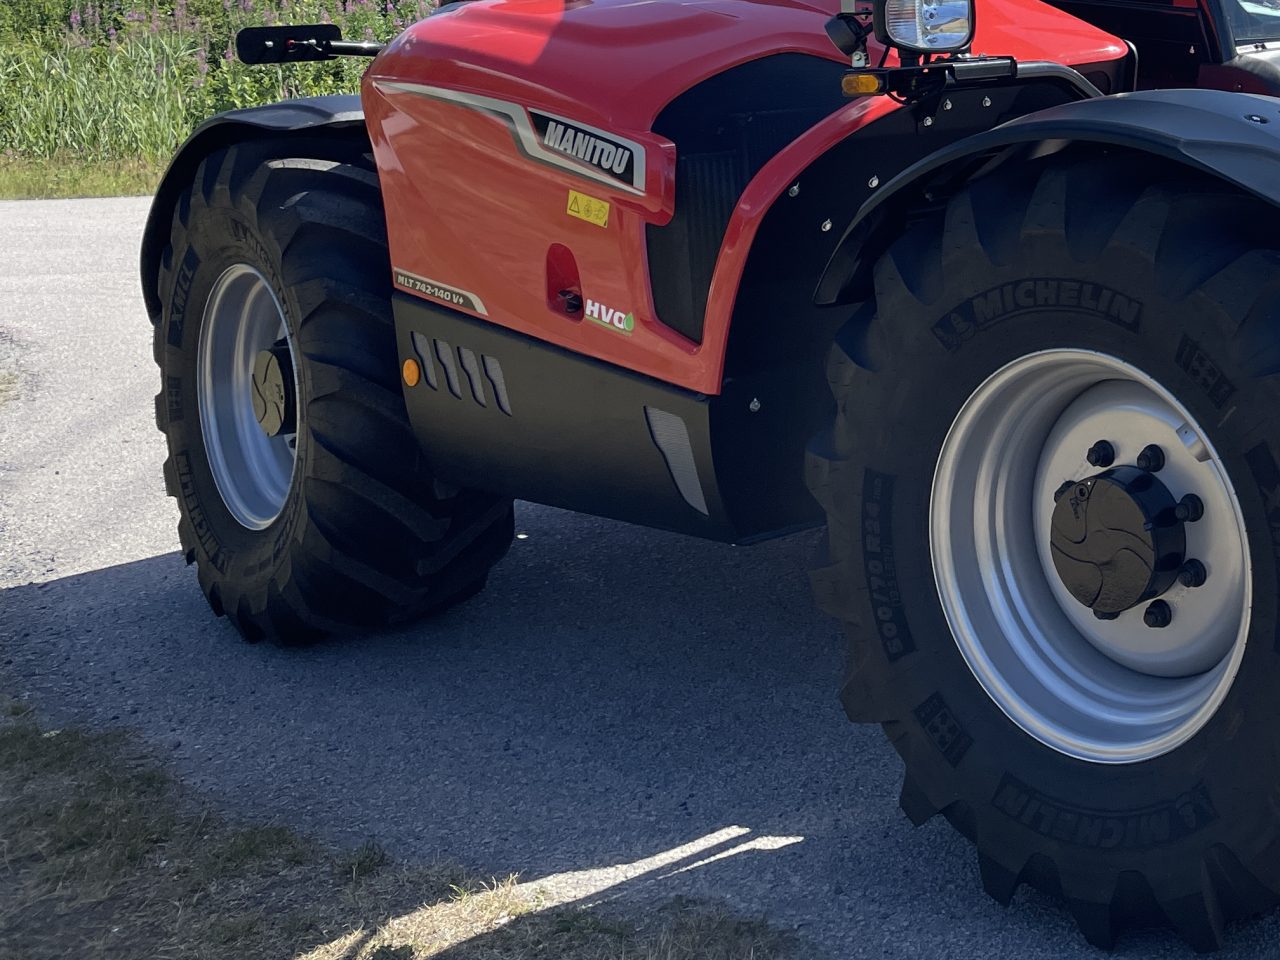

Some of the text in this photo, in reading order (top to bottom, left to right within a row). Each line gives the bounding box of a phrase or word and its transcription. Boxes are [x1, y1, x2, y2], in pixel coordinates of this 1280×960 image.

[544, 122, 630, 174] MANITOU
[170, 265, 194, 330] XMCL
[397, 275, 414, 287] MLT
[415, 281, 451, 300] 742-140
[972, 279, 1144, 325] MICHELIN
[176, 454, 221, 559] MICHELIN
[865, 501, 882, 553] R24
[867, 559, 903, 654] 500/70
[993, 784, 1170, 849] MICHELIN
